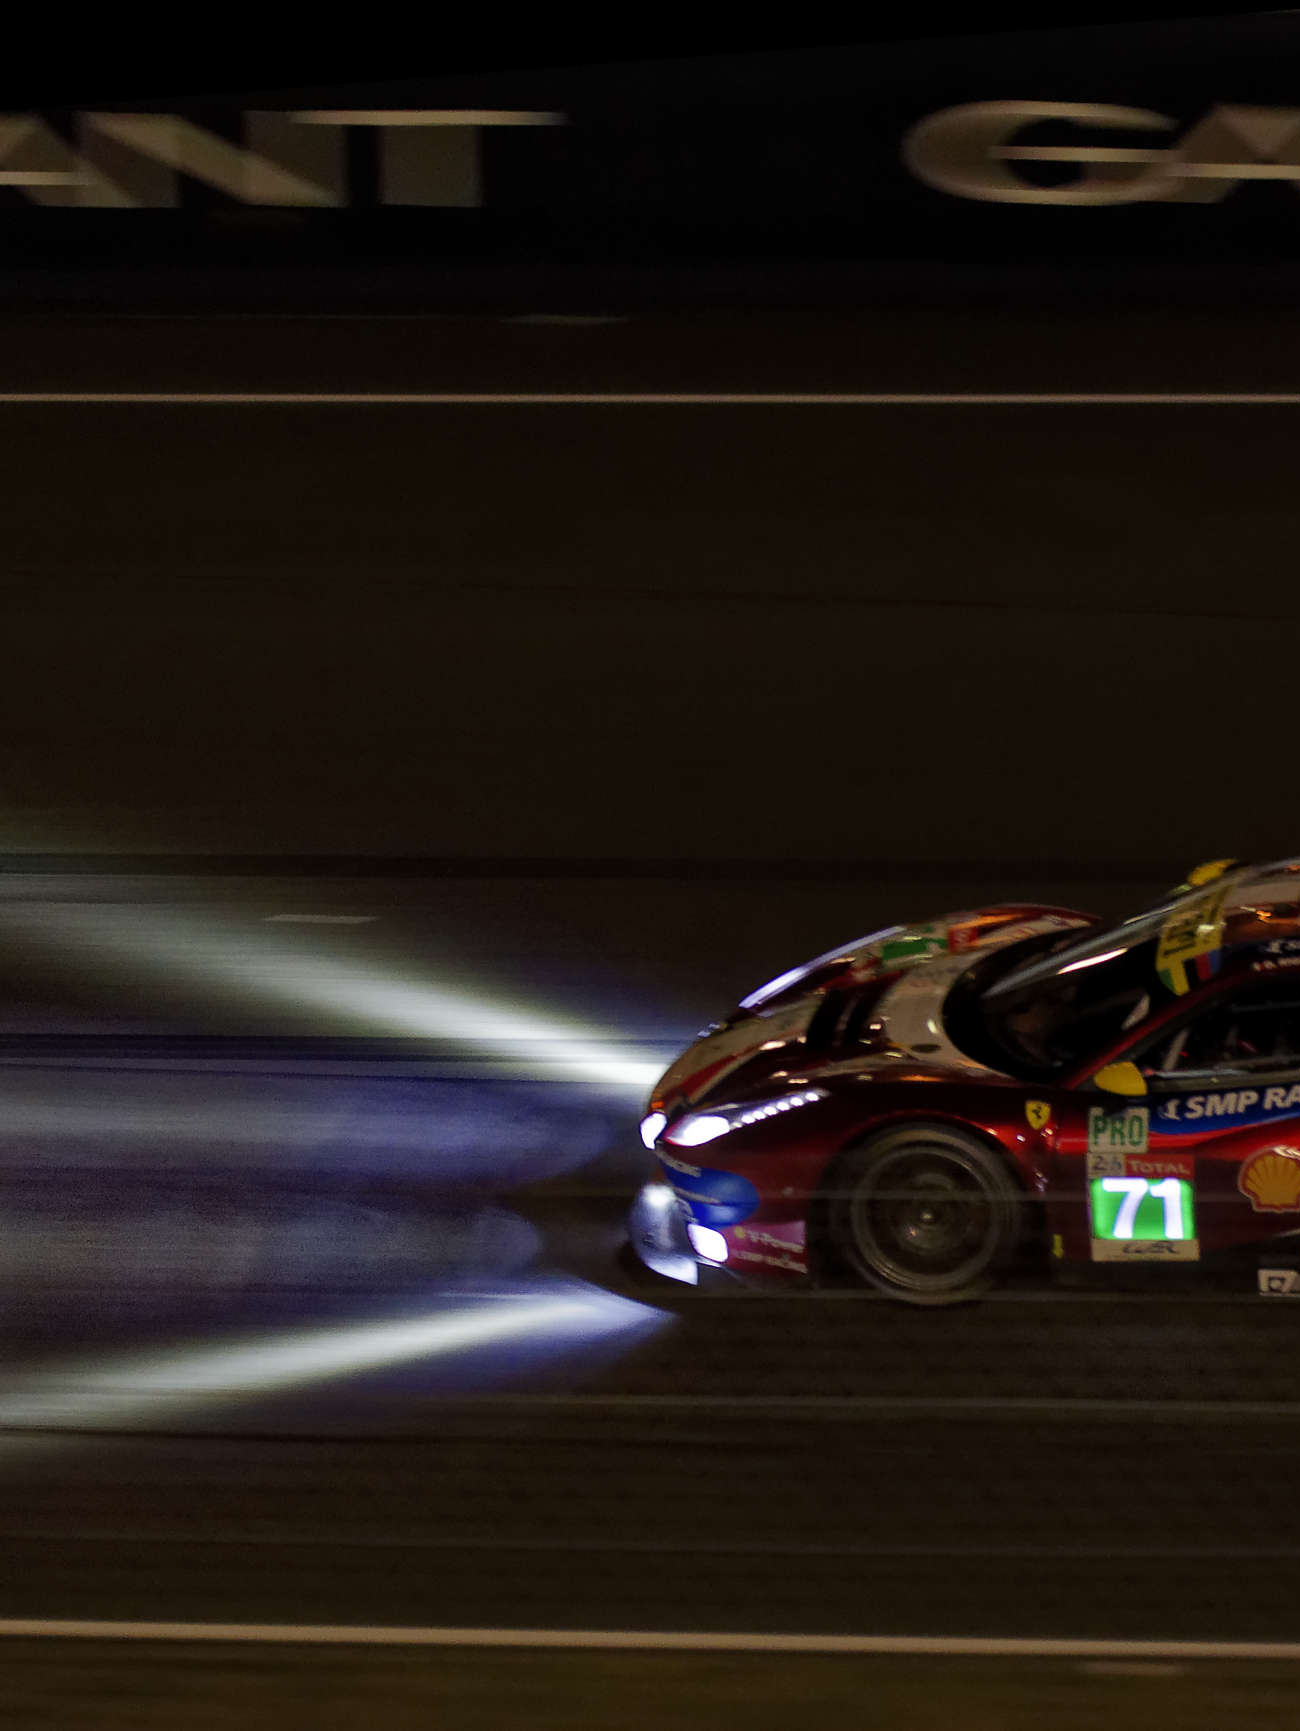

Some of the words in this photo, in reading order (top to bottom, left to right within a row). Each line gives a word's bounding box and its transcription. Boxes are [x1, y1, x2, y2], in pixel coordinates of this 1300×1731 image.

[1185, 1090, 1260, 1121] SMP
[1093, 1115, 1144, 1146] PRO
[1128, 1160, 1191, 1176] TOTAL
[1102, 1177, 1184, 1240] 71
